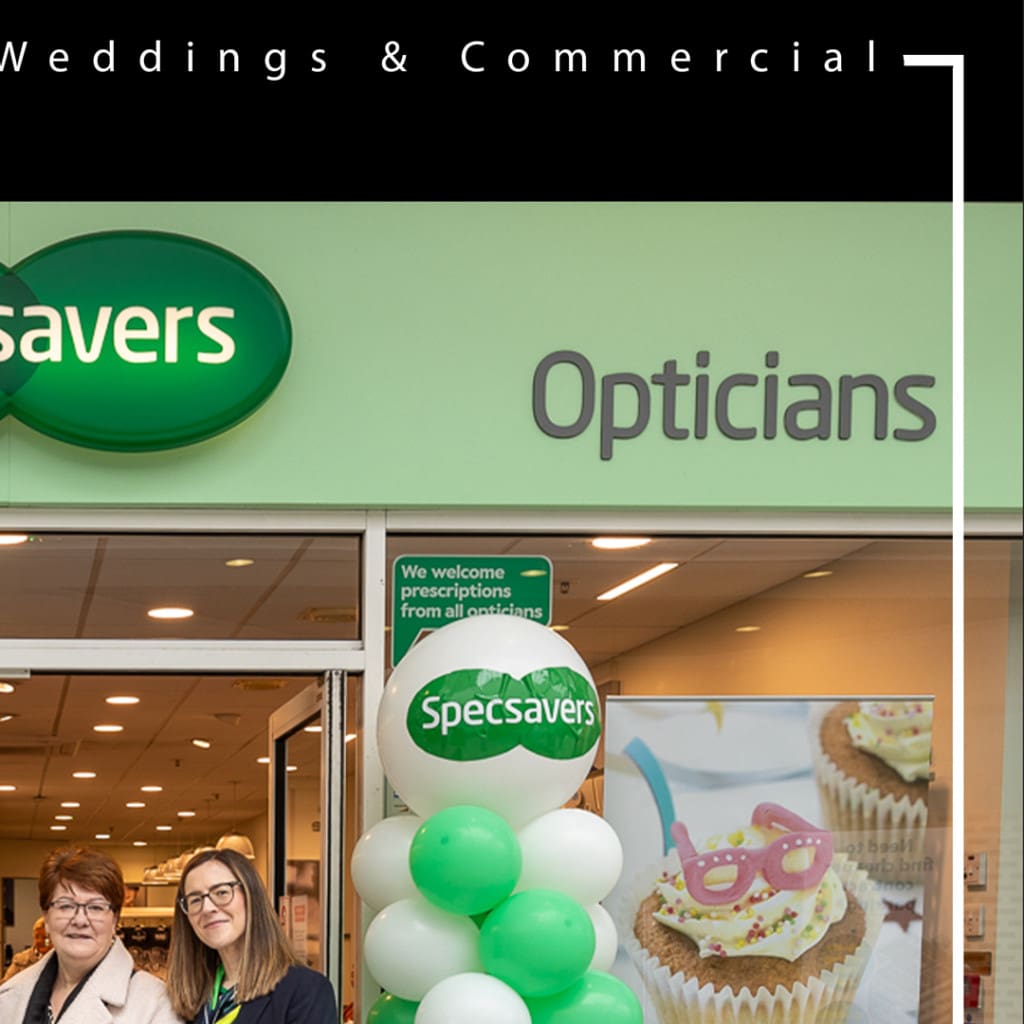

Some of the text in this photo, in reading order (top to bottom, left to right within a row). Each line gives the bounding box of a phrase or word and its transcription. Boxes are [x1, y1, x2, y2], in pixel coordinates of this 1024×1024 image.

[532, 350, 937, 461] Opticians
[401, 565, 505, 580] We welcome
[401, 583, 512, 601] prescriptions
[400, 603, 442, 618] from
[445, 603, 464, 618] all
[421, 695, 595, 736] Specsavers
